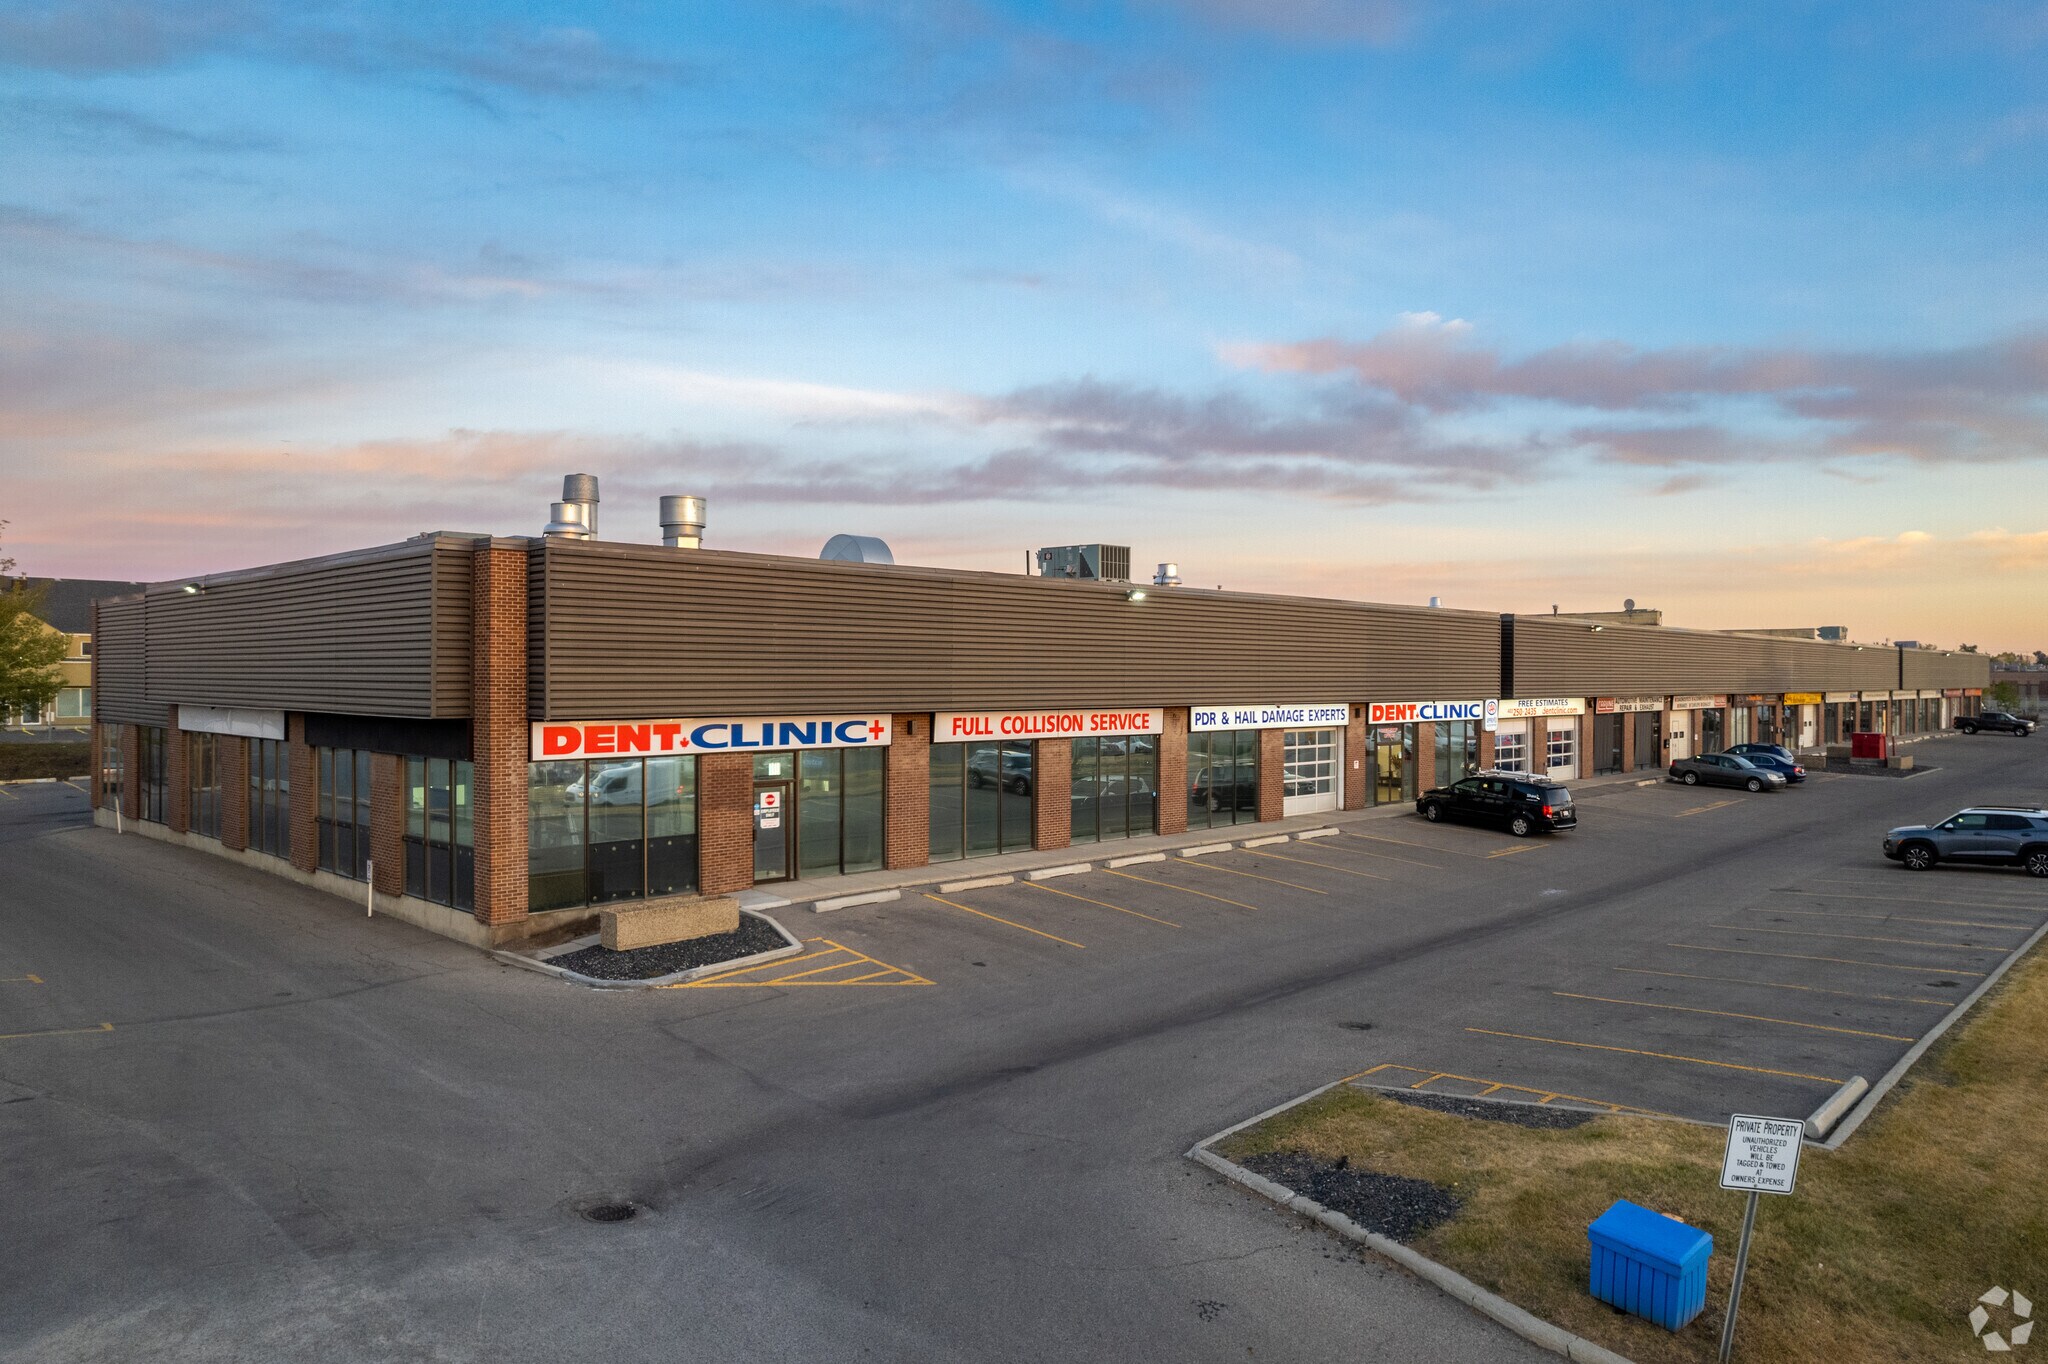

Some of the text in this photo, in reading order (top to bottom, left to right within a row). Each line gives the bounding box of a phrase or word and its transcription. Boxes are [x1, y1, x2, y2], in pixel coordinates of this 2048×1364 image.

[1518, 700, 1534, 708] FREE
[1195, 708, 1346, 726] PDR & HAIL DAMAGE EXPERTS
[1372, 704, 1480, 722] DENT CLINIC
[952, 713, 1150, 736] FULL COLLISION SERVICE
[543, 720, 867, 755] DENT CLINIC
[1736, 1121, 1798, 1137] PRIVATE PROPERTY
[1742, 1136, 1787, 1146] UNAUTHORIZED
[1750, 1145, 1778, 1154] VEHICLES
[1737, 1160, 1758, 1168] TAGGED
[1766, 1162, 1785, 1170] TOWED
[1731, 1175, 1785, 1186] OWNERS EXPENSE
